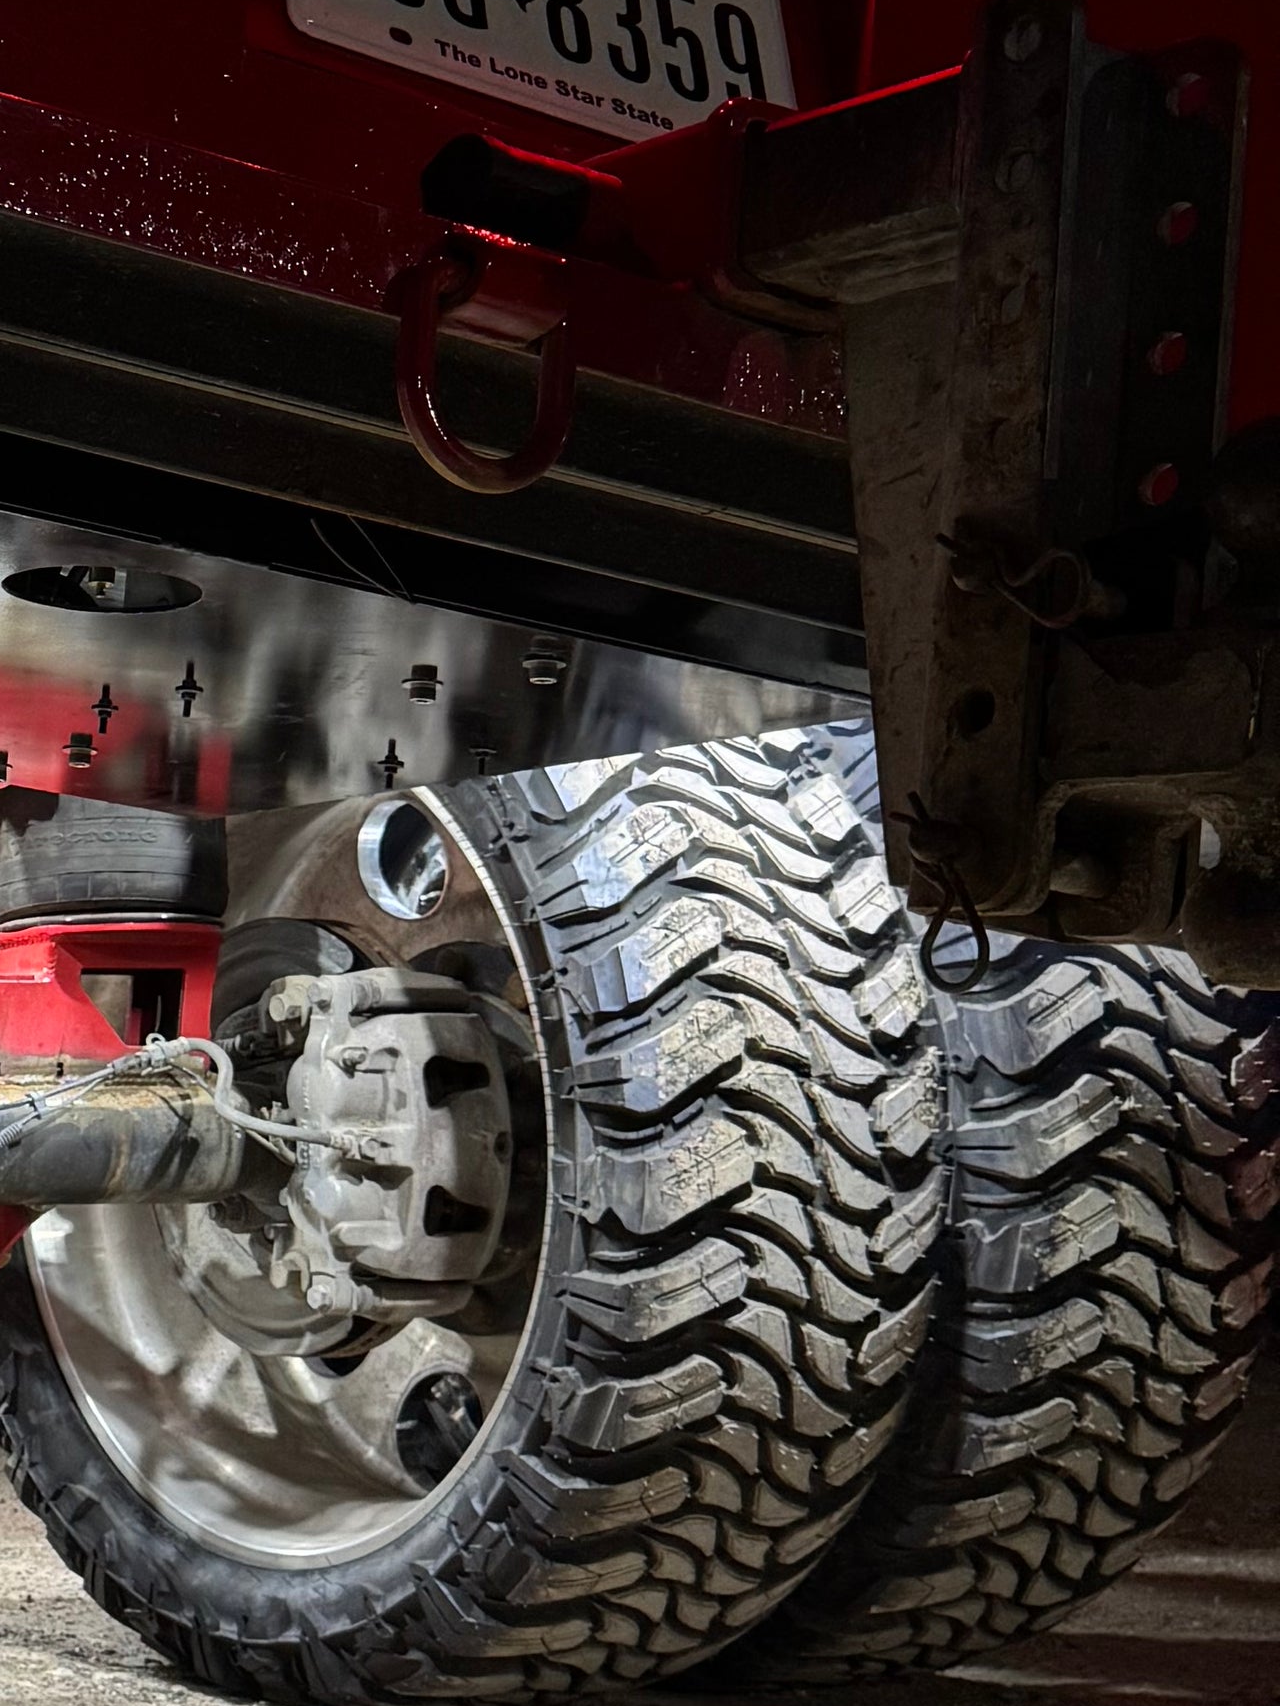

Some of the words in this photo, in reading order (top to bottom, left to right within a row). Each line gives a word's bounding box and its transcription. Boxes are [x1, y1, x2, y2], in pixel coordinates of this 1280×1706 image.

[434, 39, 482, 69] The
[489, 57, 548, 90] Lone
[555, 80, 605, 109] Star
[611, 98, 674, 131] State
